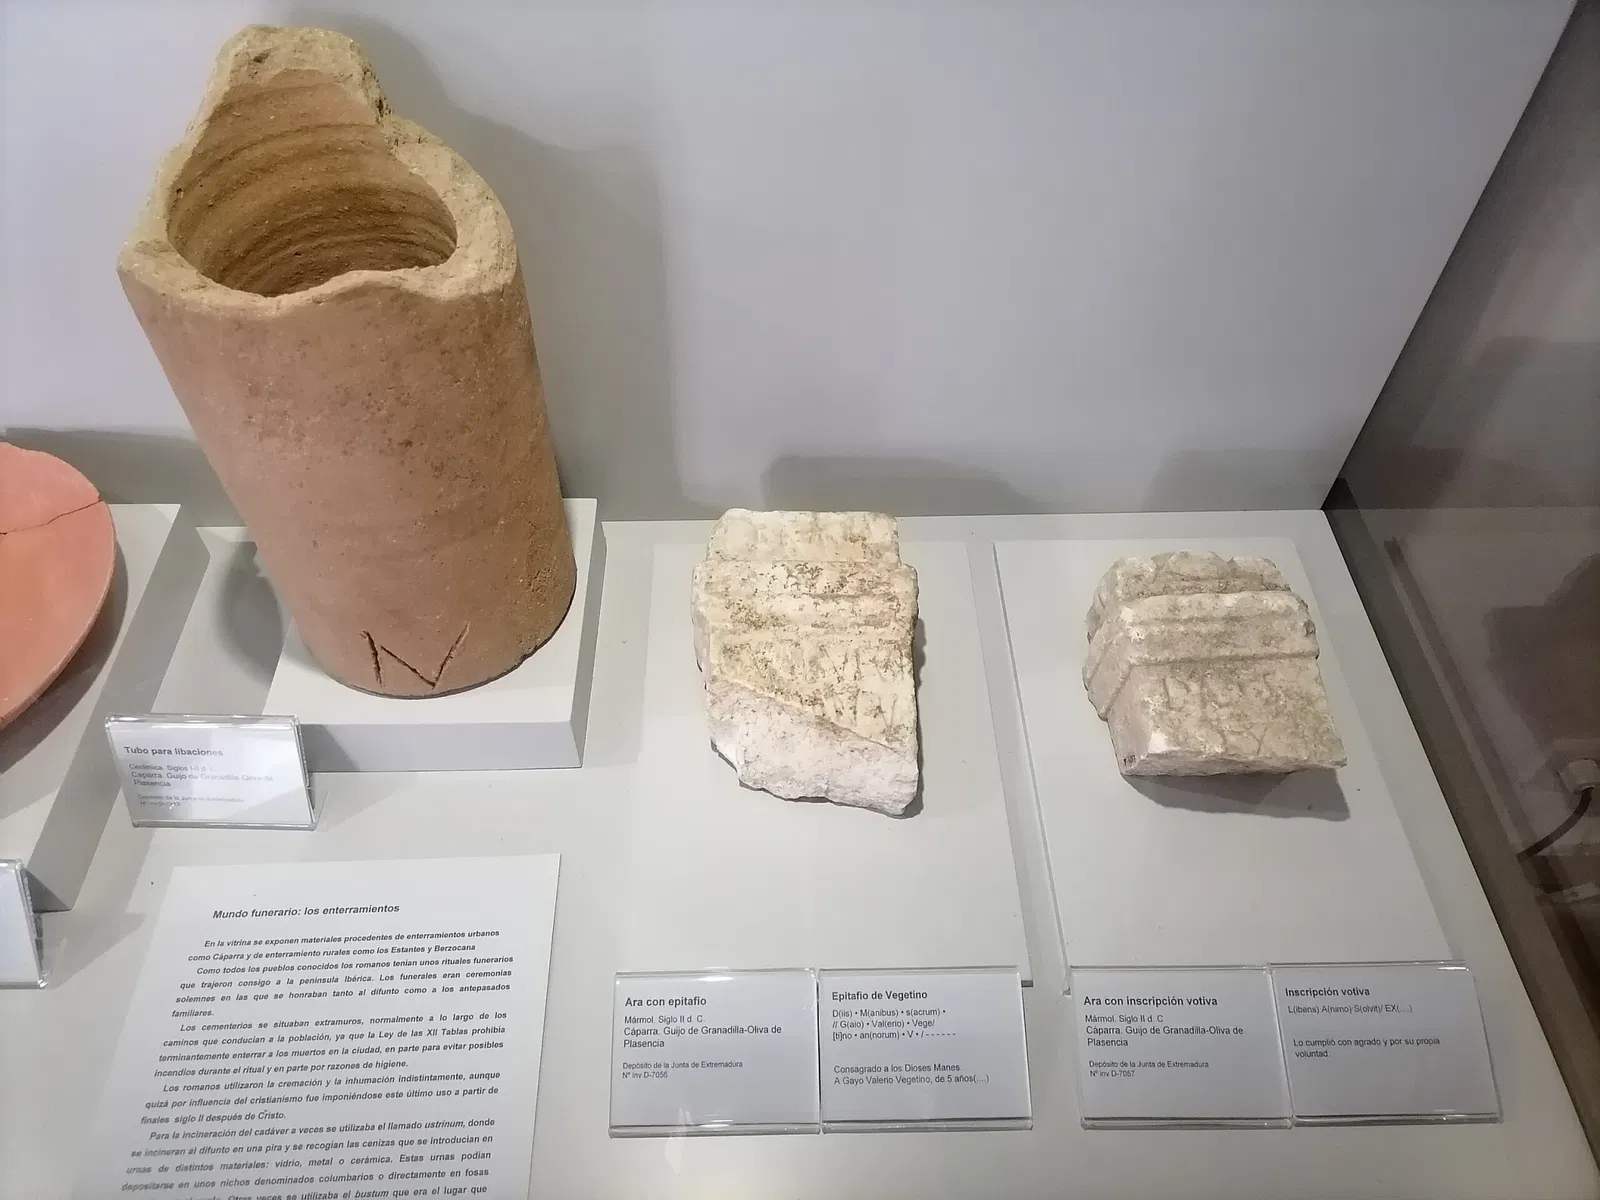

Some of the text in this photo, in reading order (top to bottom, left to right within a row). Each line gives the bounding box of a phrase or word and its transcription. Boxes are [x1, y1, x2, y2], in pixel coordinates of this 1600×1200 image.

[124, 746, 148, 754] Tubo
[213, 904, 399, 918] Mundo funerario: los enterramientos
[265, 938, 299, 946] exponen
[344, 934, 392, 944] procedentes
[406, 932, 465, 940] enterramientos
[213, 953, 244, 961] Cáparra
[265, 949, 321, 958] enterramiento
[322, 948, 350, 956] rurales
[223, 965, 246, 973] todos
[262, 964, 294, 974] pueblos
[297, 962, 339, 970] conocidos
[441, 957, 471, 965] rituales
[474, 956, 513, 964] funerarios
[832, 990, 927, 1002] Epitafio de Vegetino
[1285, 987, 1370, 998] Inscripción votiva
[625, 996, 706, 1008] Ara con epitafio
[1084, 996, 1217, 1008] Ara con inscripción votiva
[172, 1008, 214, 1017] familiares.
[201, 1022, 252, 1031] cementerios
[273, 1020, 309, 1028] situaban
[315, 1019, 364, 1028] extramuros,
[370, 1016, 423, 1024] normalmente
[452, 1013, 474, 1022] largo
[494, 1011, 507, 1019] los
[658, 1015, 678, 1025] Siglo
[1119, 1014, 1138, 1024] Siglo
[663, 1026, 685, 1036] Guijo
[688, 1026, 698, 1034] de
[701, 1025, 768, 1034] Granadilla-Oliva
[771, 1025, 781, 1033] de
[1125, 1025, 1148, 1036] Guijo
[1150, 1025, 1160, 1034] de
[1163, 1026, 1230, 1034] Granadilla-Oliva
[1233, 1026, 1243, 1034] de
[624, 1038, 664, 1048] Plasencia
[1088, 1037, 1128, 1048] Plasencia
[834, 1064, 882, 1074] Consagrado
[891, 1064, 904, 1072] los
[905, 1064, 931, 1073] Dioses
[834, 1076, 840, 1084] A
[842, 1075, 864, 1086] Gayo
[895, 1075, 932, 1085] Vegetino,
[935, 1074, 945, 1083] de
[947, 1074, 953, 1082] 5
